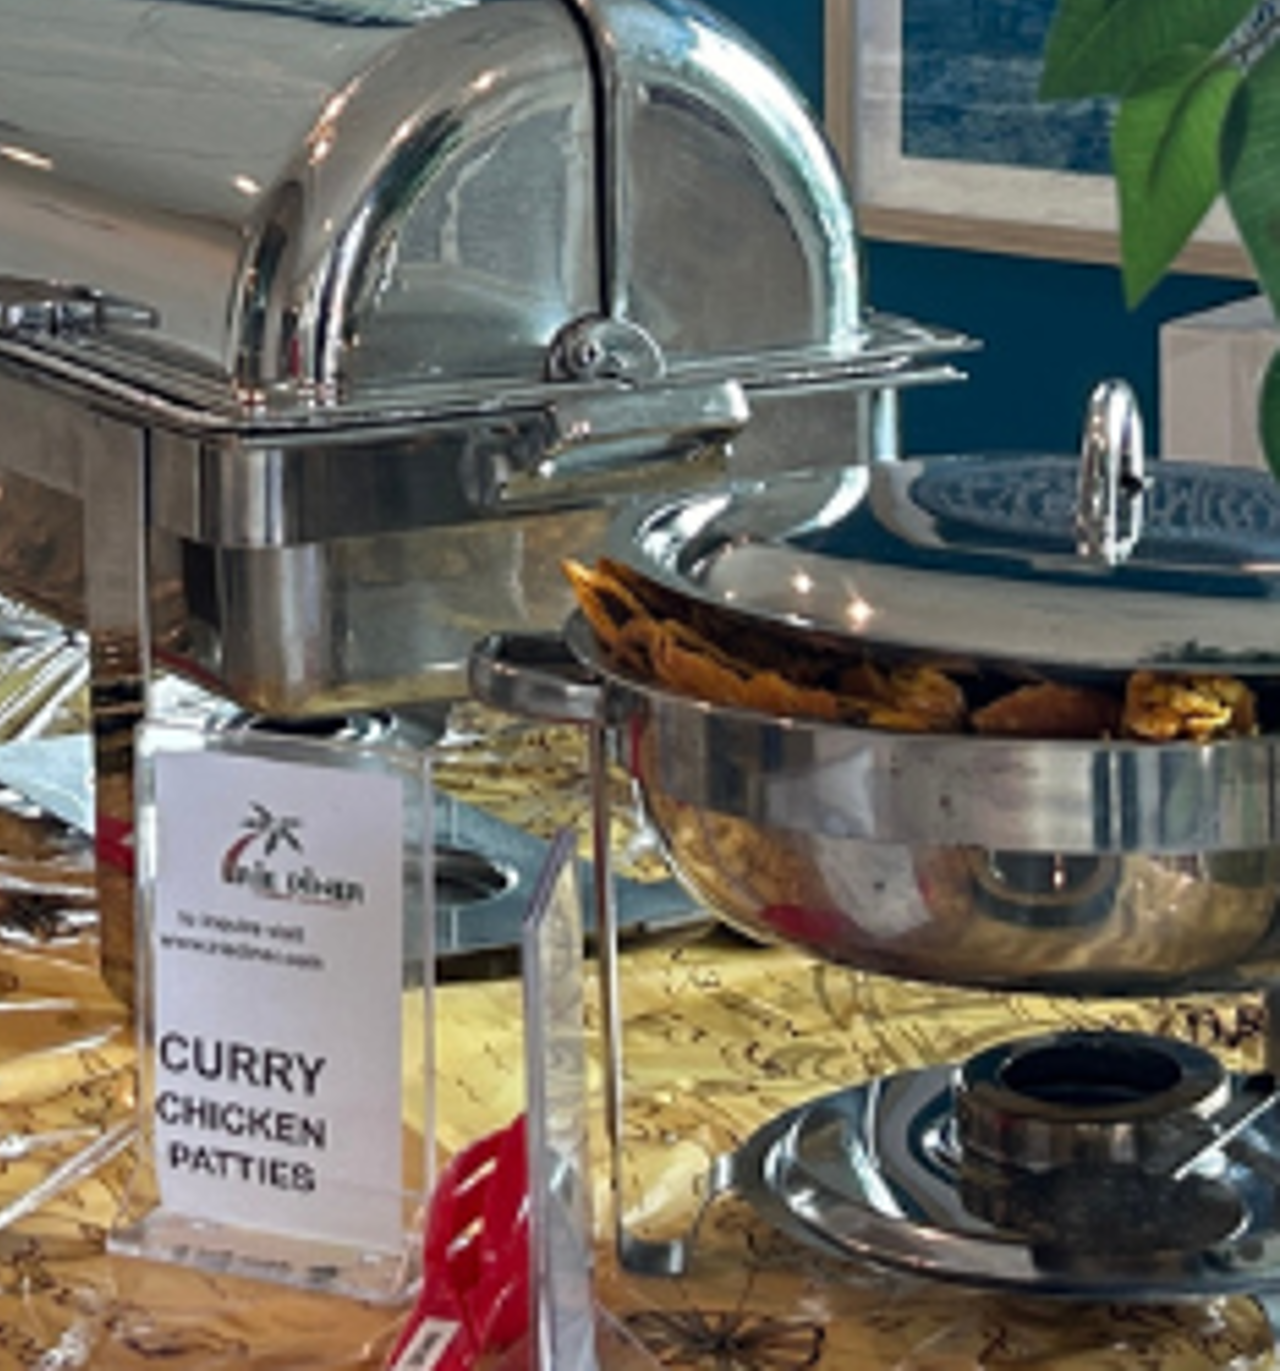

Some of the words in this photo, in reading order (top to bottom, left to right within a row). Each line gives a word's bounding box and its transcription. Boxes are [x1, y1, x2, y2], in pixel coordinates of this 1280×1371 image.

[159, 1032, 327, 1097] CURRY
[154, 1090, 327, 1150] CHICKEN
[168, 1140, 317, 1195] PATTIES
